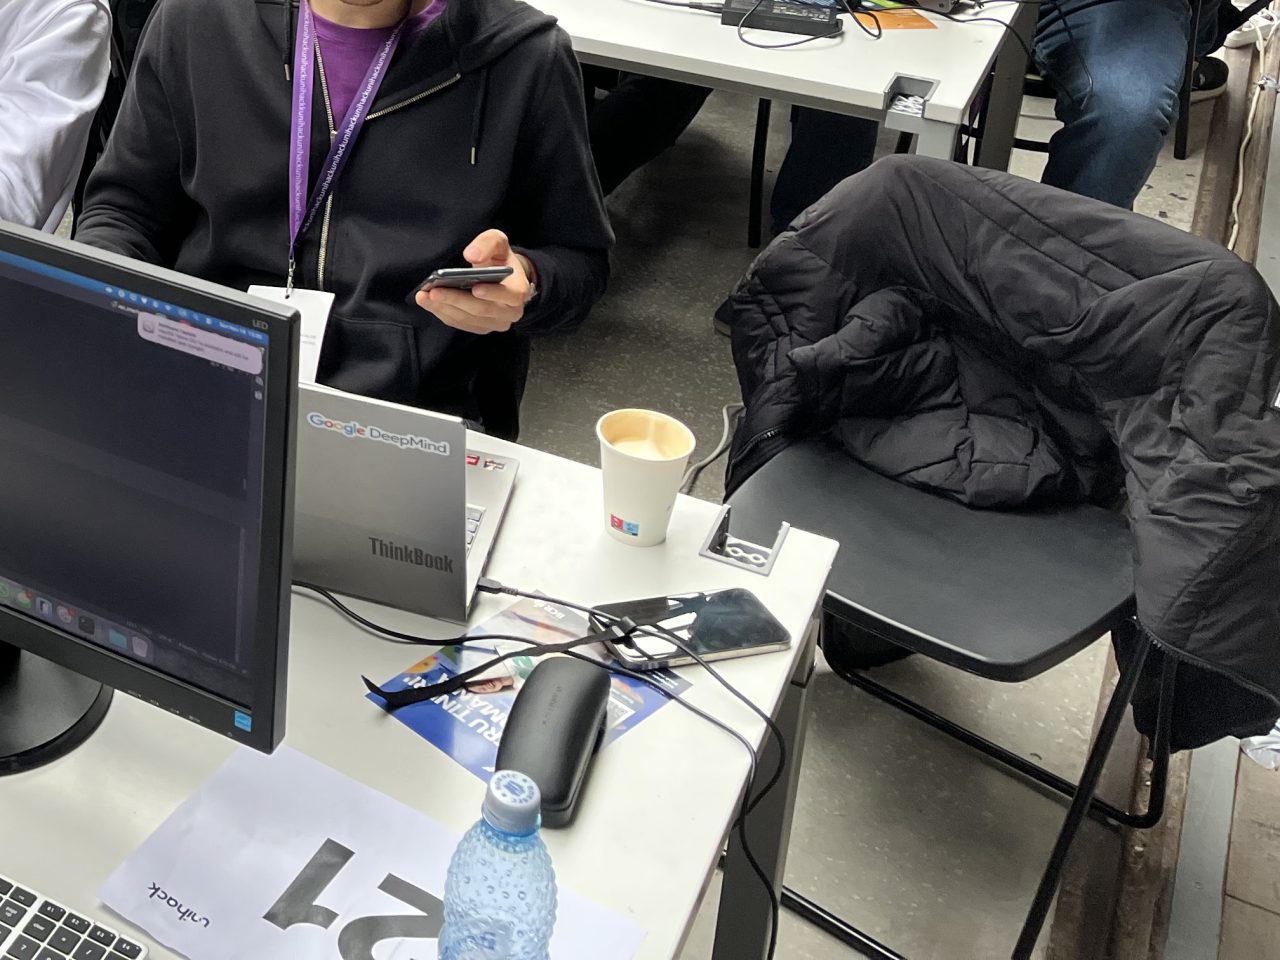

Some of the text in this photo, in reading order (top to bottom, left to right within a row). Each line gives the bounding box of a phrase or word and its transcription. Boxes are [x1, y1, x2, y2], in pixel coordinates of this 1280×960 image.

[252, 319, 269, 330] LED
[309, 413, 447, 454] Google DeepMind
[369, 537, 454, 574] ThinkBook
[543, 603, 566, 619] BCR
[148, 881, 210, 929] unihack
